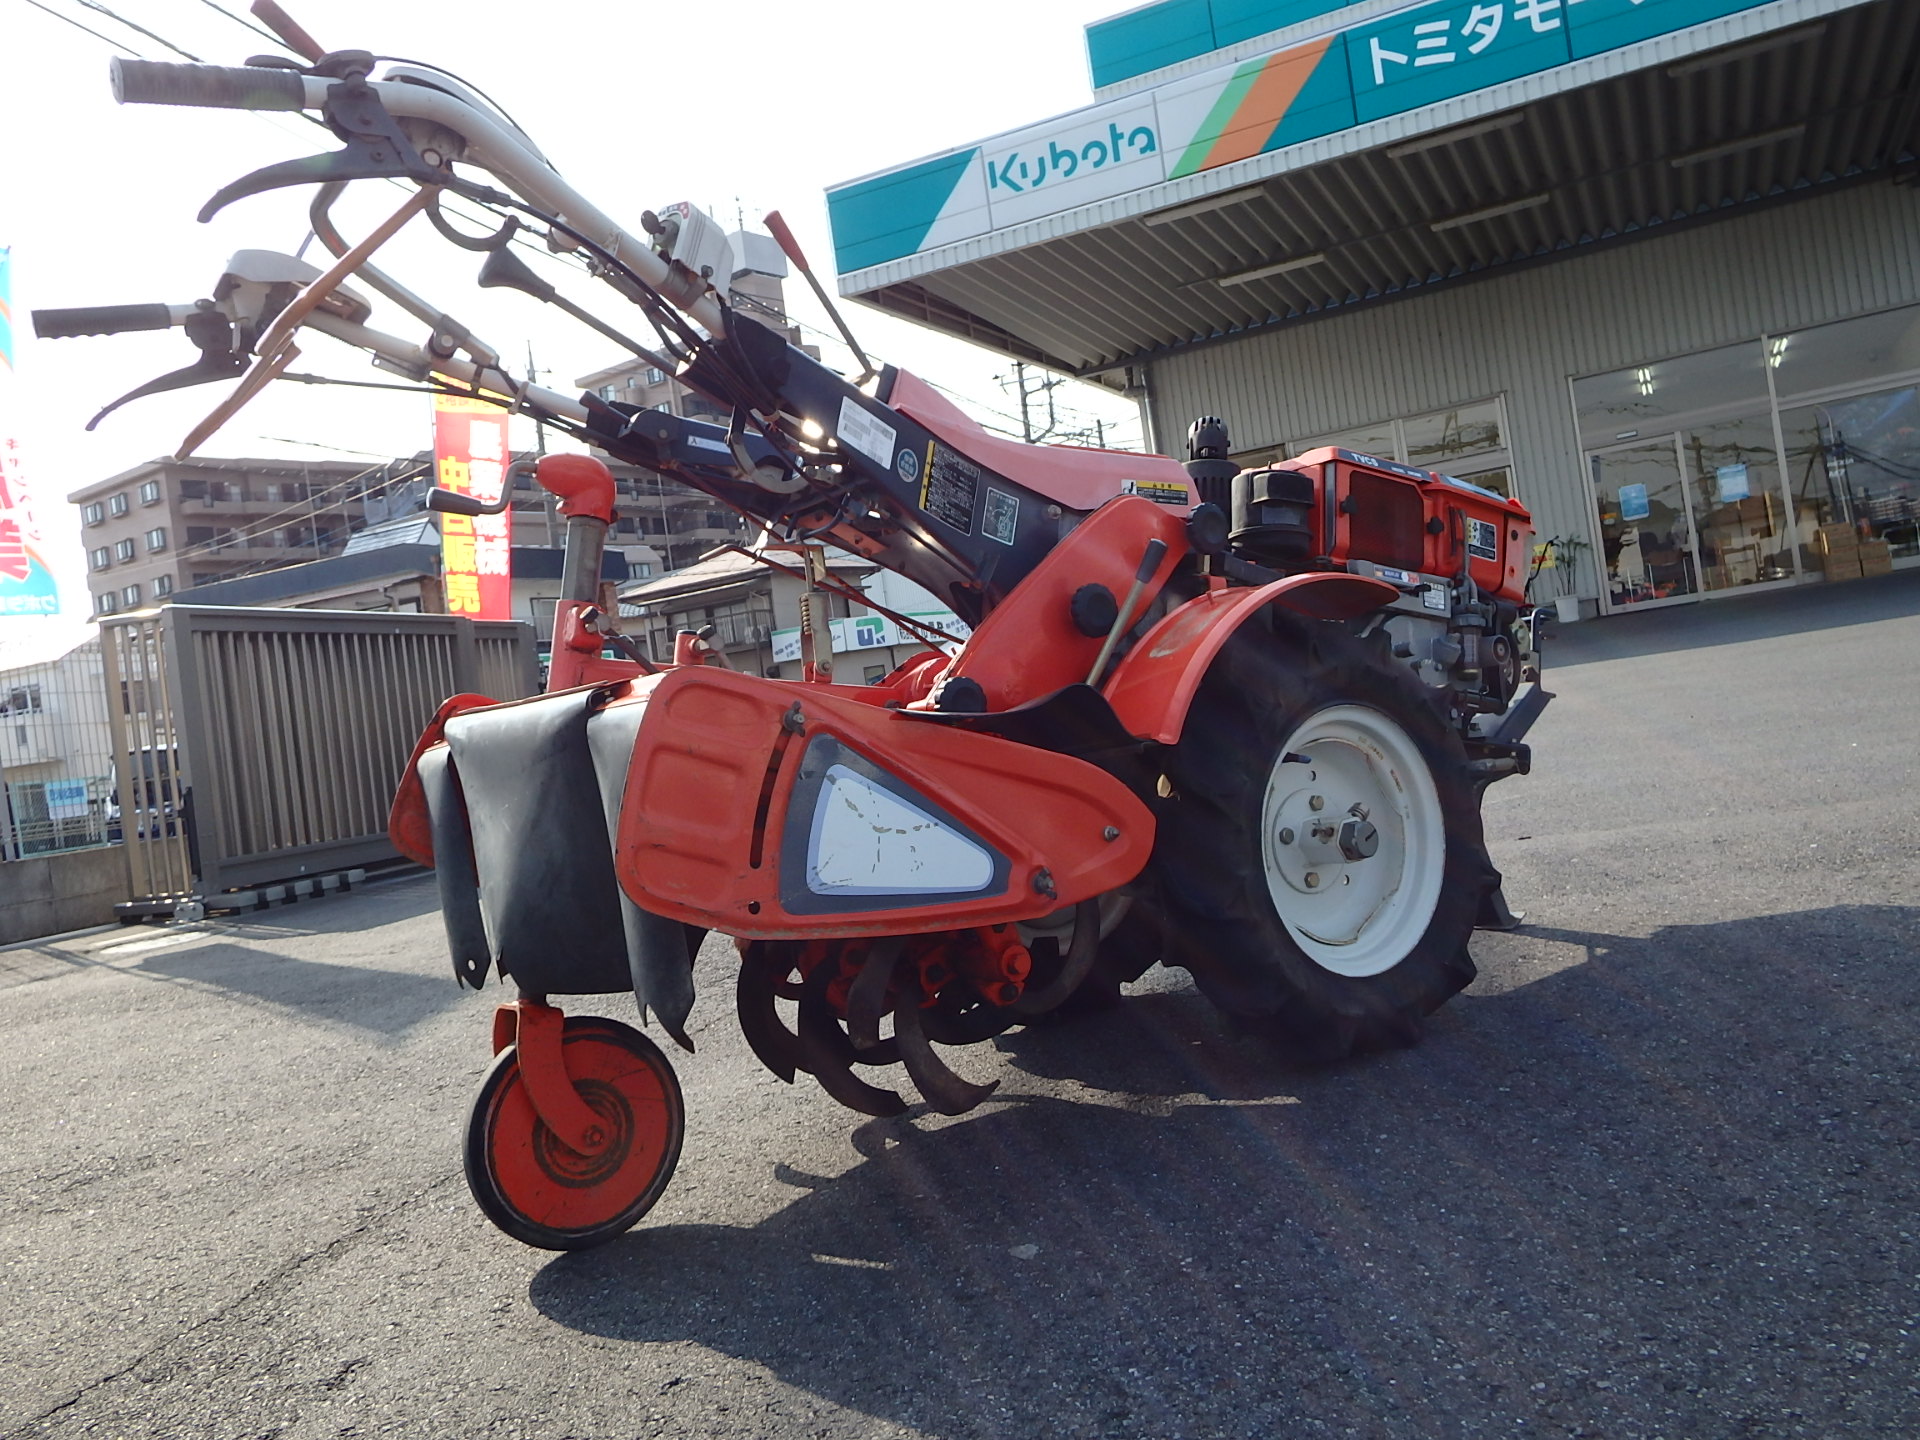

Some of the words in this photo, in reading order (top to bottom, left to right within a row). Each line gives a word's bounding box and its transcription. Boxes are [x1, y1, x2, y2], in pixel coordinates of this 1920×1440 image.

[1370, 0, 1645, 85] トミタモ
[988, 123, 1156, 192] Kubota
[1351, 453, 1378, 467] TVCS
[439, 456, 481, 613] 中古販売
